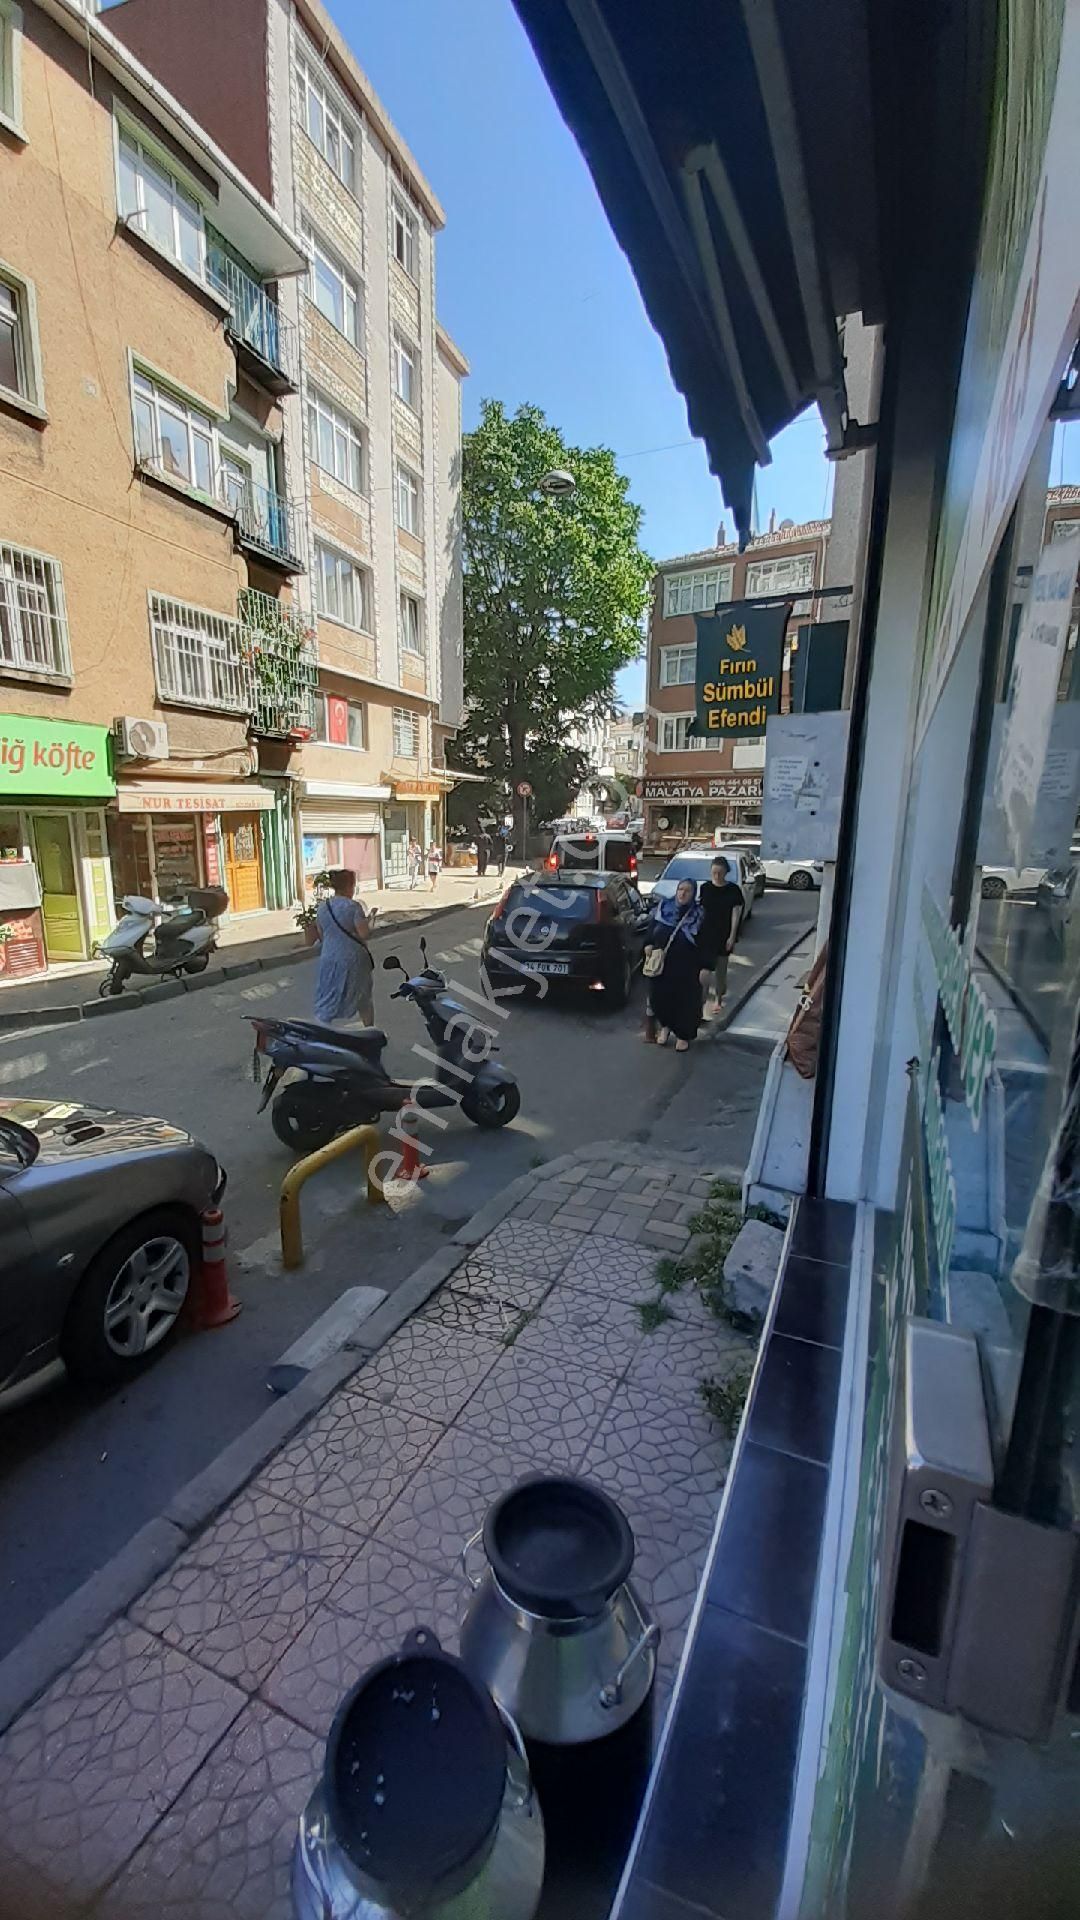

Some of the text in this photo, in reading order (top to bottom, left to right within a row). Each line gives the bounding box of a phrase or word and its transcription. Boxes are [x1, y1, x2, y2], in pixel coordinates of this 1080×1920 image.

[720, 659, 757, 675] Fırın
[703, 678, 773, 703] Sümbül
[708, 706, 767, 729] Efendi
[0, 737, 96, 776] iğ köfte
[646, 786, 704, 797] MALATYA
[143, 796, 172, 809] NUR
[176, 796, 226, 809] TESİSAT
